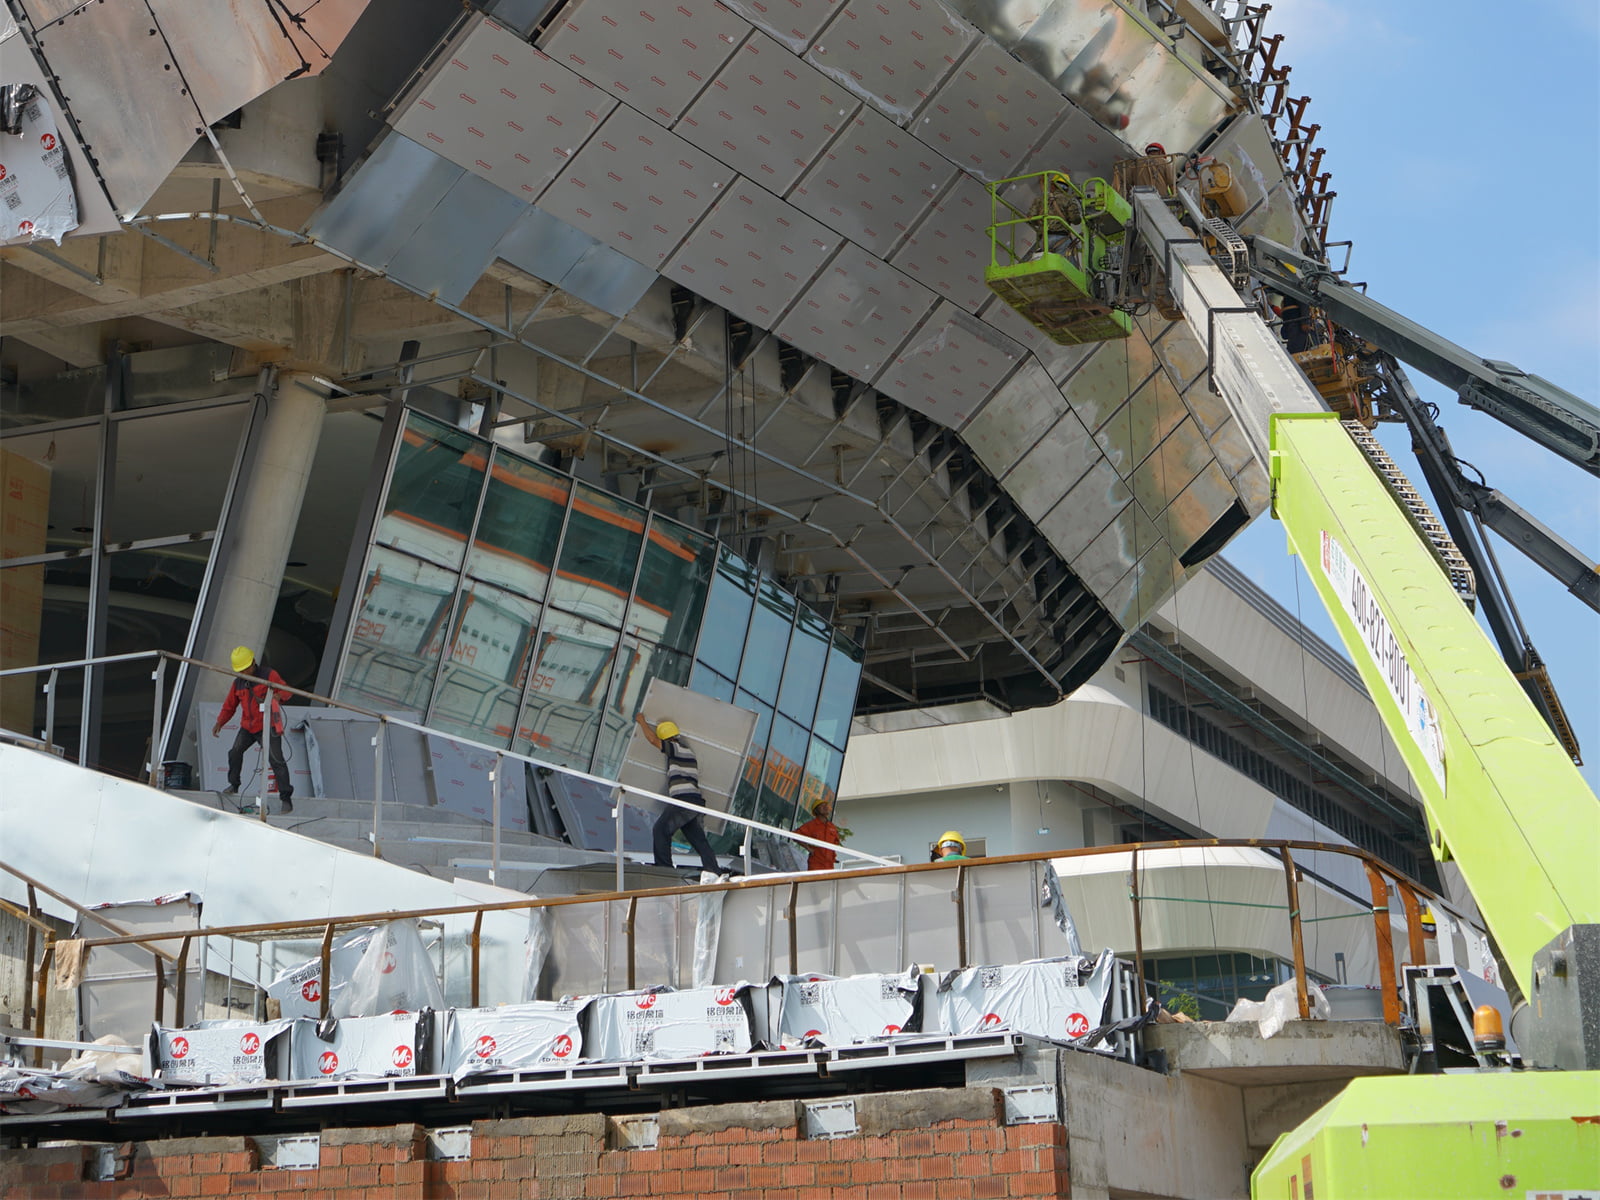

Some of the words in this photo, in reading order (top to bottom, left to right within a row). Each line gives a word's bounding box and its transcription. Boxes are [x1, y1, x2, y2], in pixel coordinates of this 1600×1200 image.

[1351, 568, 1410, 716] 400-821-8001
[1065, 1014, 1088, 1036] Mc
[170, 1037, 188, 1058] Mc
[241, 1033, 260, 1055] Mc
[318, 1052, 338, 1074] Mc
[392, 1045, 412, 1067] Mc
